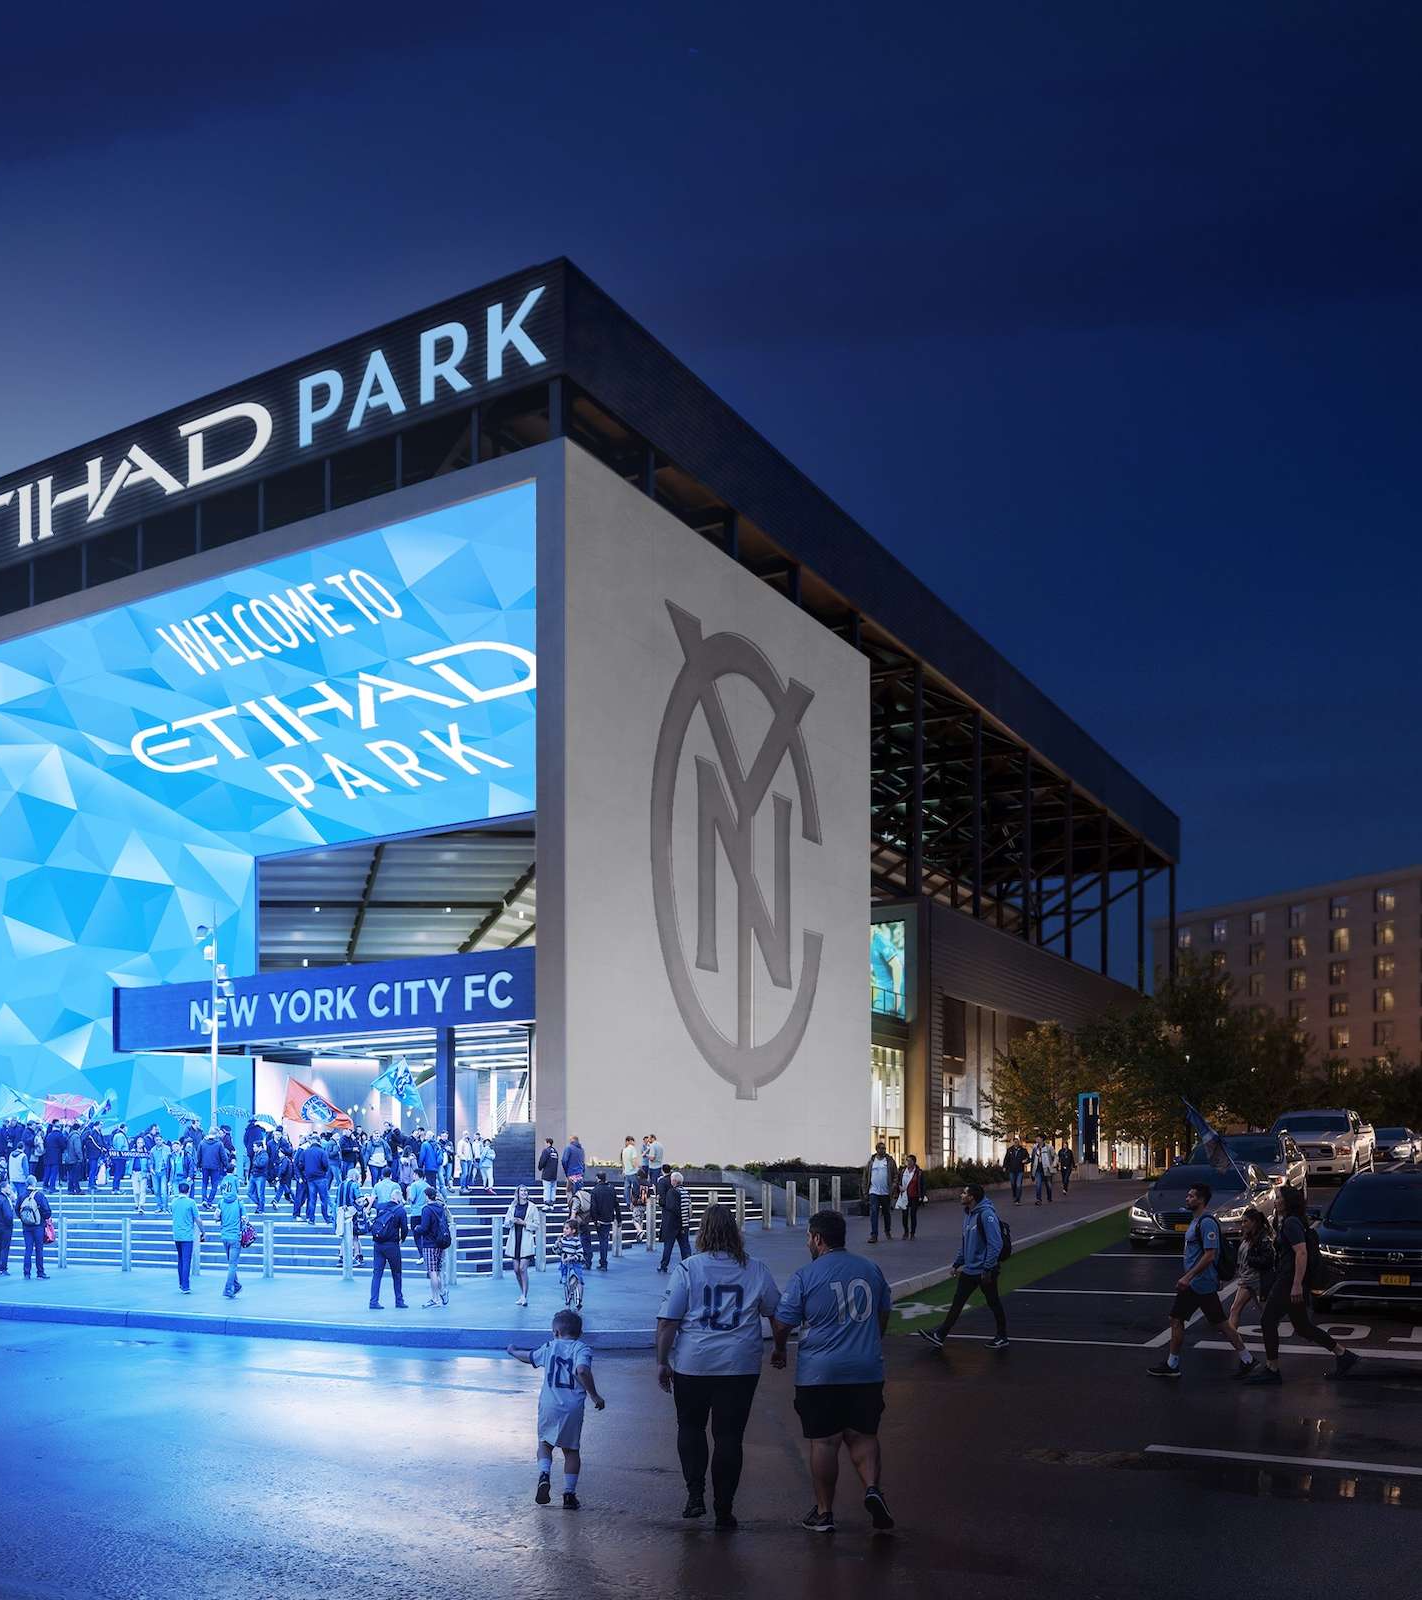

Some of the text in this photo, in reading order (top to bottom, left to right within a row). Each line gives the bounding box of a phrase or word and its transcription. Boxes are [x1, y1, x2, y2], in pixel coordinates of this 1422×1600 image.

[298, 285, 547, 448] PARK
[156, 570, 403, 676] WELCOME TO
[130, 640, 536, 775] ETIHAD
[264, 722, 514, 809] PARK
[269, 986, 357, 1024] YORK
[368, 977, 451, 1018] CITY
[464, 971, 513, 1011] FC
[700, 1284, 744, 1330] 10
[829, 1277, 873, 1324] 10
